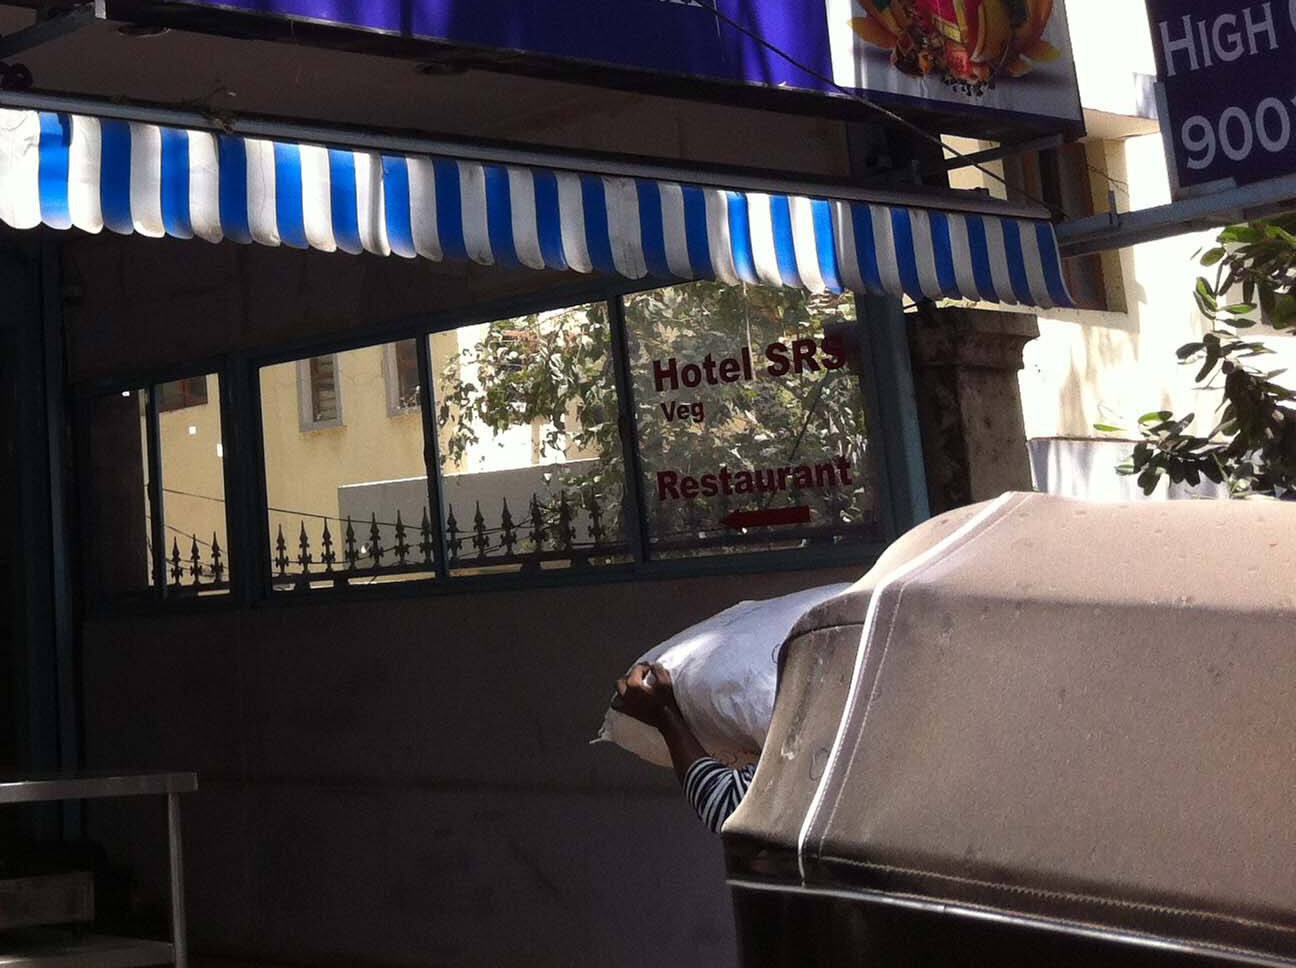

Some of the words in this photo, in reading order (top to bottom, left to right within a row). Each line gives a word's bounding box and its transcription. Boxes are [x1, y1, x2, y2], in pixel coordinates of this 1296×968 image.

[1159, 1, 1279, 78] HIGH
[1180, 95, 1296, 170] 900
[653, 346, 752, 392] Hotel
[765, 334, 848, 377] SRS
[660, 400, 704, 422] Veg
[656, 455, 853, 501] Restaurant
